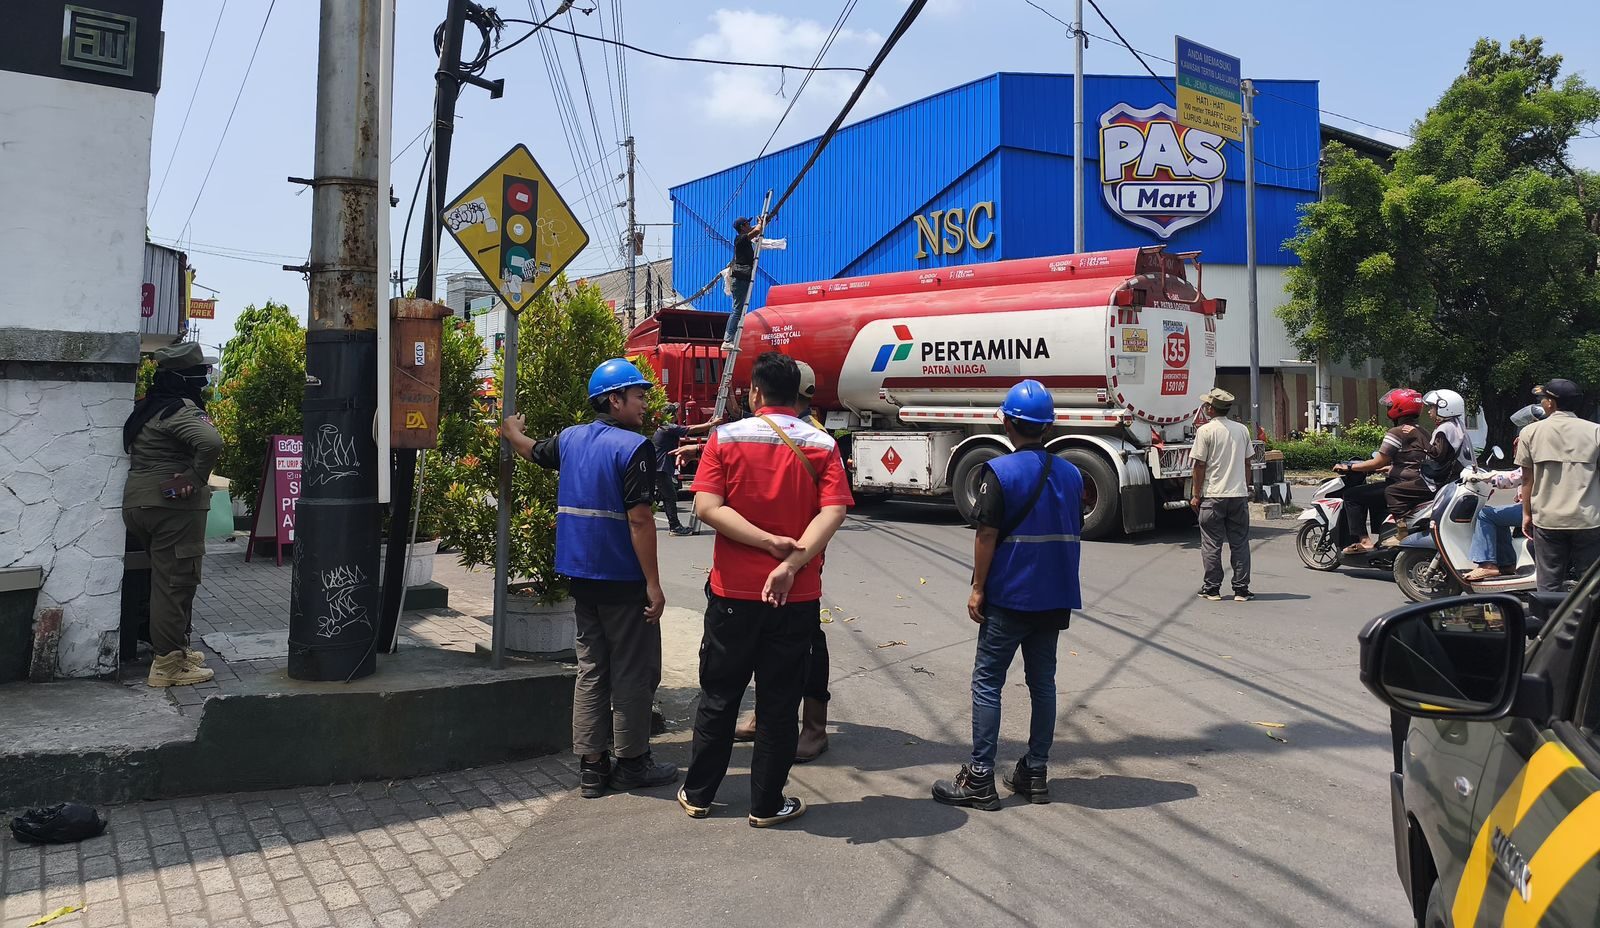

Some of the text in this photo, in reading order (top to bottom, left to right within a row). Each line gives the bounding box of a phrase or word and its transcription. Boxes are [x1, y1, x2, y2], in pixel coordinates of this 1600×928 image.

[1187, 48, 1232, 72] ANDA MEMASUKI
[1195, 95, 1209, 106] HATI
[1212, 100, 1226, 111] HATI
[1183, 111, 1239, 134] LURUS JALAN TERUS
[1204, 108, 1224, 120] TRAFFIC
[1224, 114, 1238, 124] LIGHT
[1100, 121, 1227, 184] PAS
[1136, 188, 1198, 208] Mart
[913, 201, 995, 259] NSC
[1162, 319, 1183, 327] PERTAMINA
[761, 330, 801, 341] EMERGENCY CALL
[771, 337, 790, 346] 150109
[921, 337, 1051, 362] PERTAMINA
[1165, 338, 1187, 362] 135
[922, 363, 987, 375] PATRA NIAGA
[1165, 381, 1185, 392] 150109
[286, 459, 299, 468] URIP
